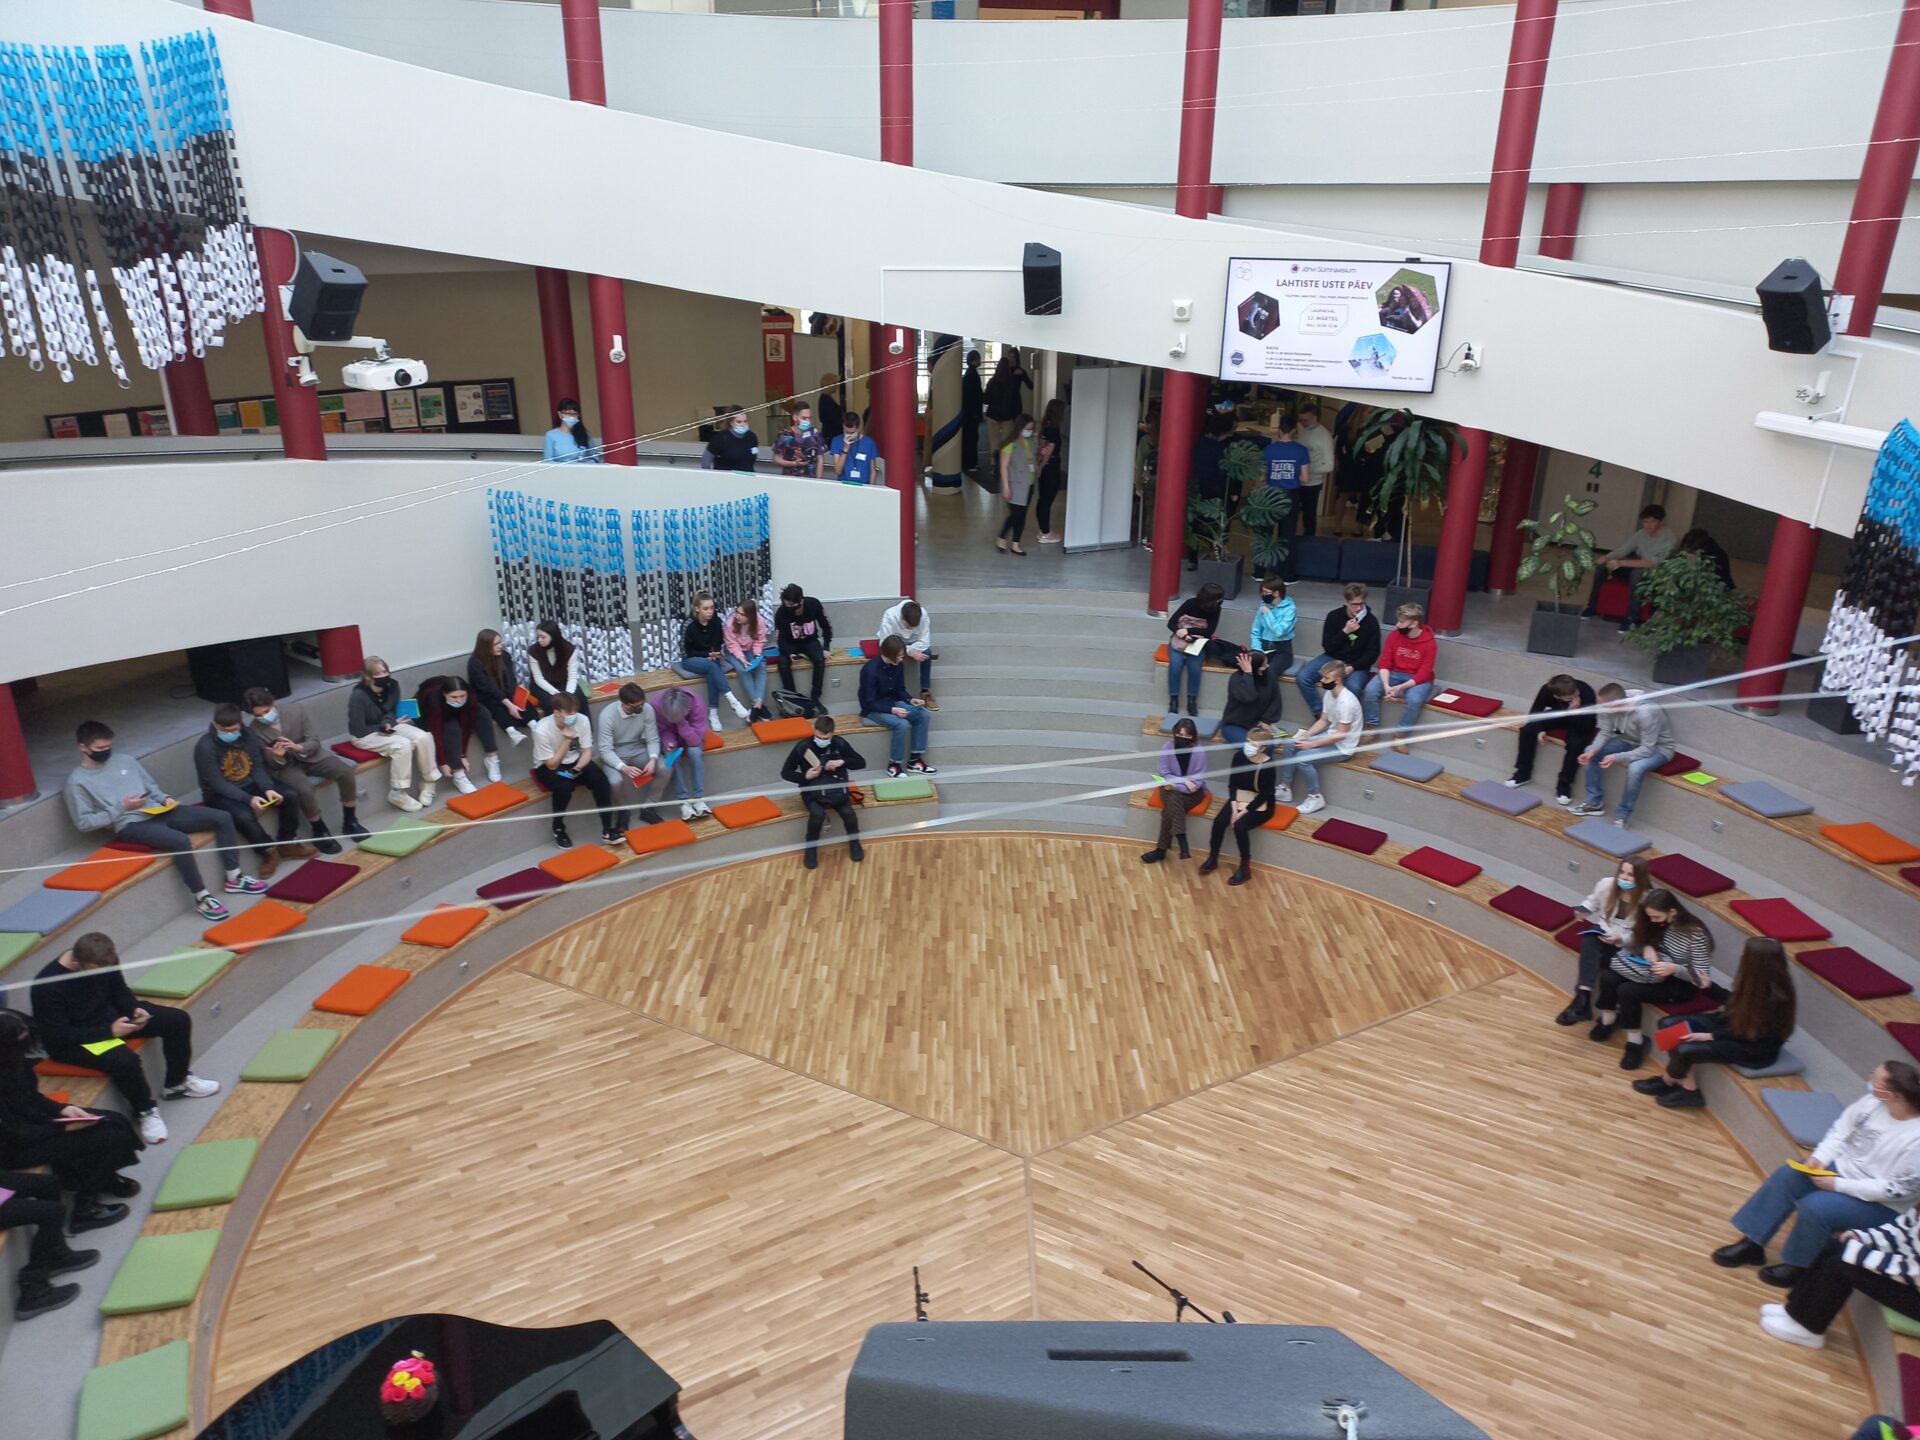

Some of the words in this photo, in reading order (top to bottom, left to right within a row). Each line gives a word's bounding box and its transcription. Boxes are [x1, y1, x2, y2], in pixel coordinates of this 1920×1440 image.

[1276, 279, 1320, 288] LAHTISTE
[1322, 280, 1346, 289] USTE
[1347, 280, 1373, 289] PÄEV
[1588, 460, 1603, 479] 4
